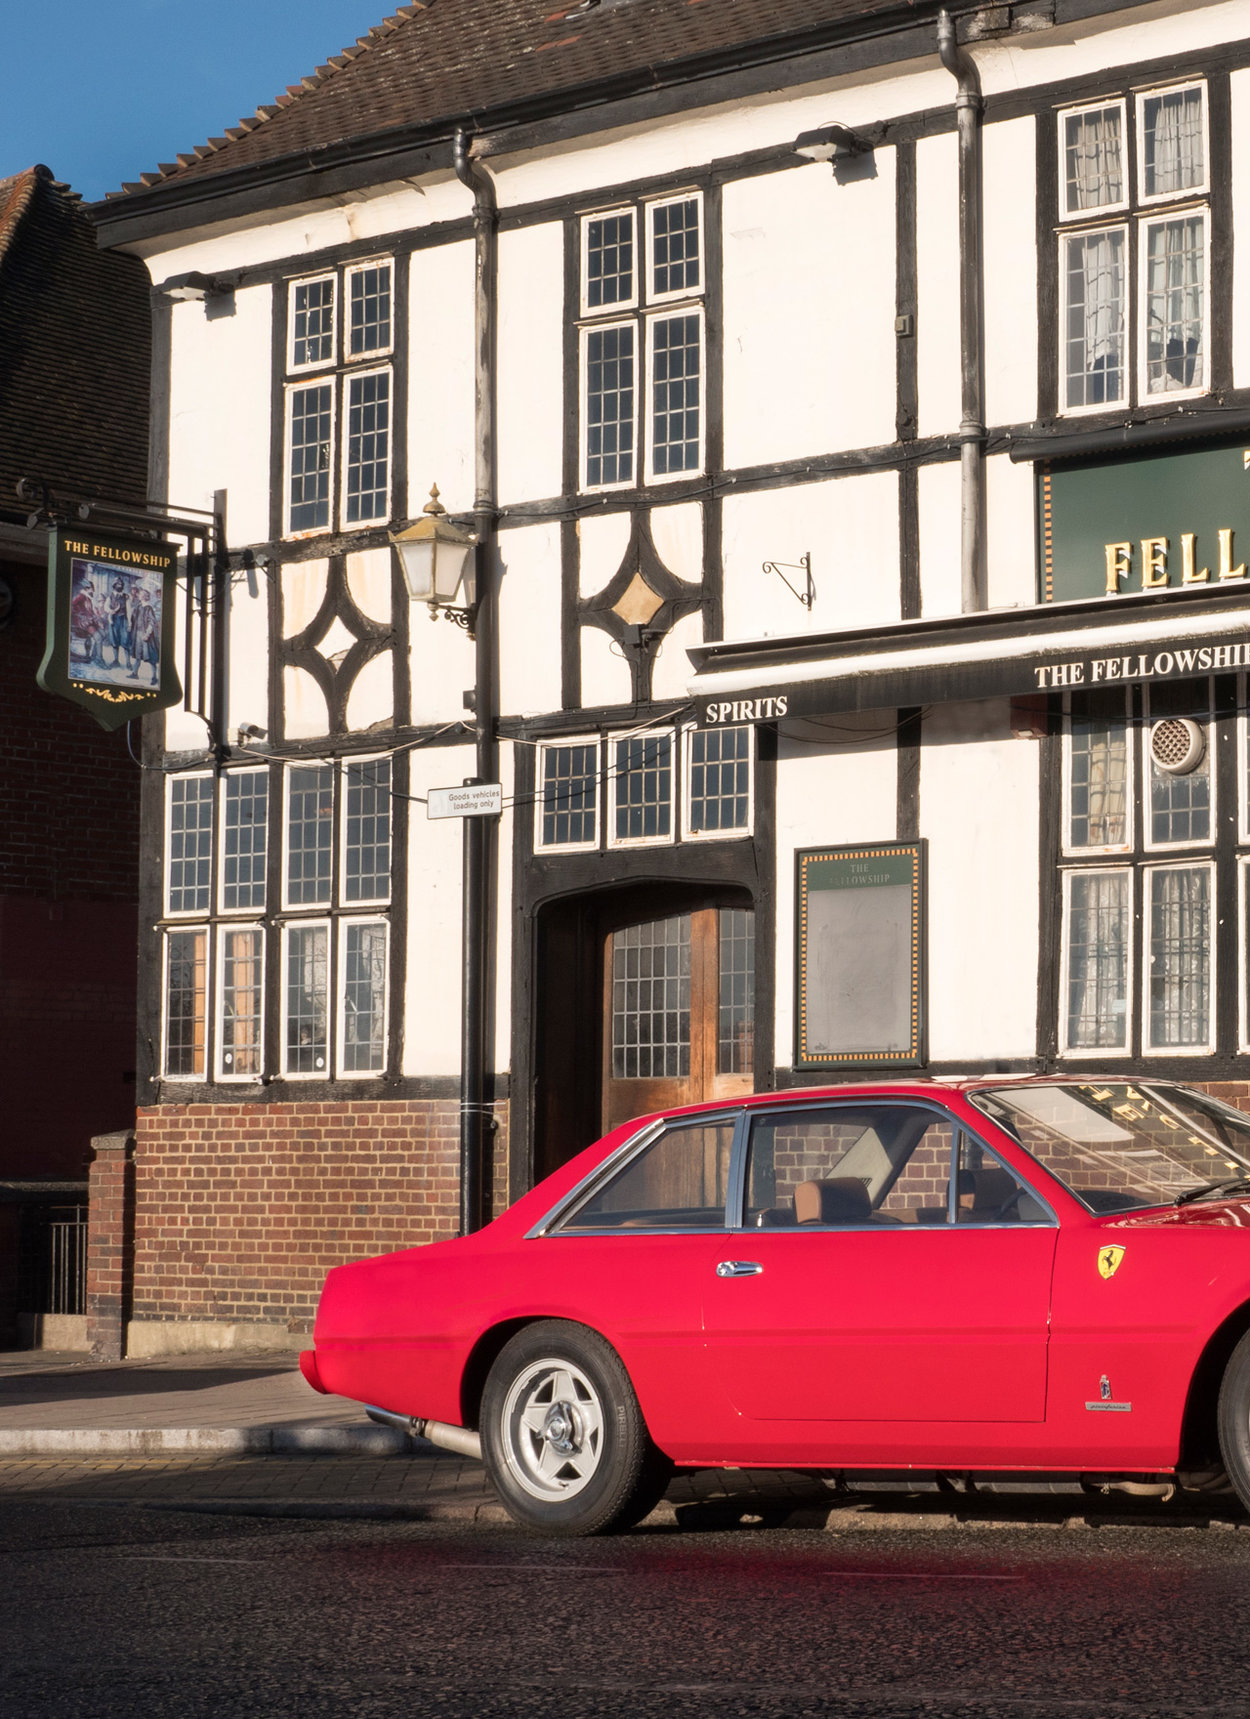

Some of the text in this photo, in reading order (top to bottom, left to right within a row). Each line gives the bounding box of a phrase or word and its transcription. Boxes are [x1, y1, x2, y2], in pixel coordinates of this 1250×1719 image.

[64, 540, 171, 568] THE FELLOWSHIP
[1034, 661, 1085, 688] THE
[705, 696, 788, 724] SPIRITS
[448, 790, 500, 801] Goods vehicles
[453, 800, 494, 810] loading only
[850, 864, 869, 873] THE
[617, 1406, 627, 1448] PIRELLI
